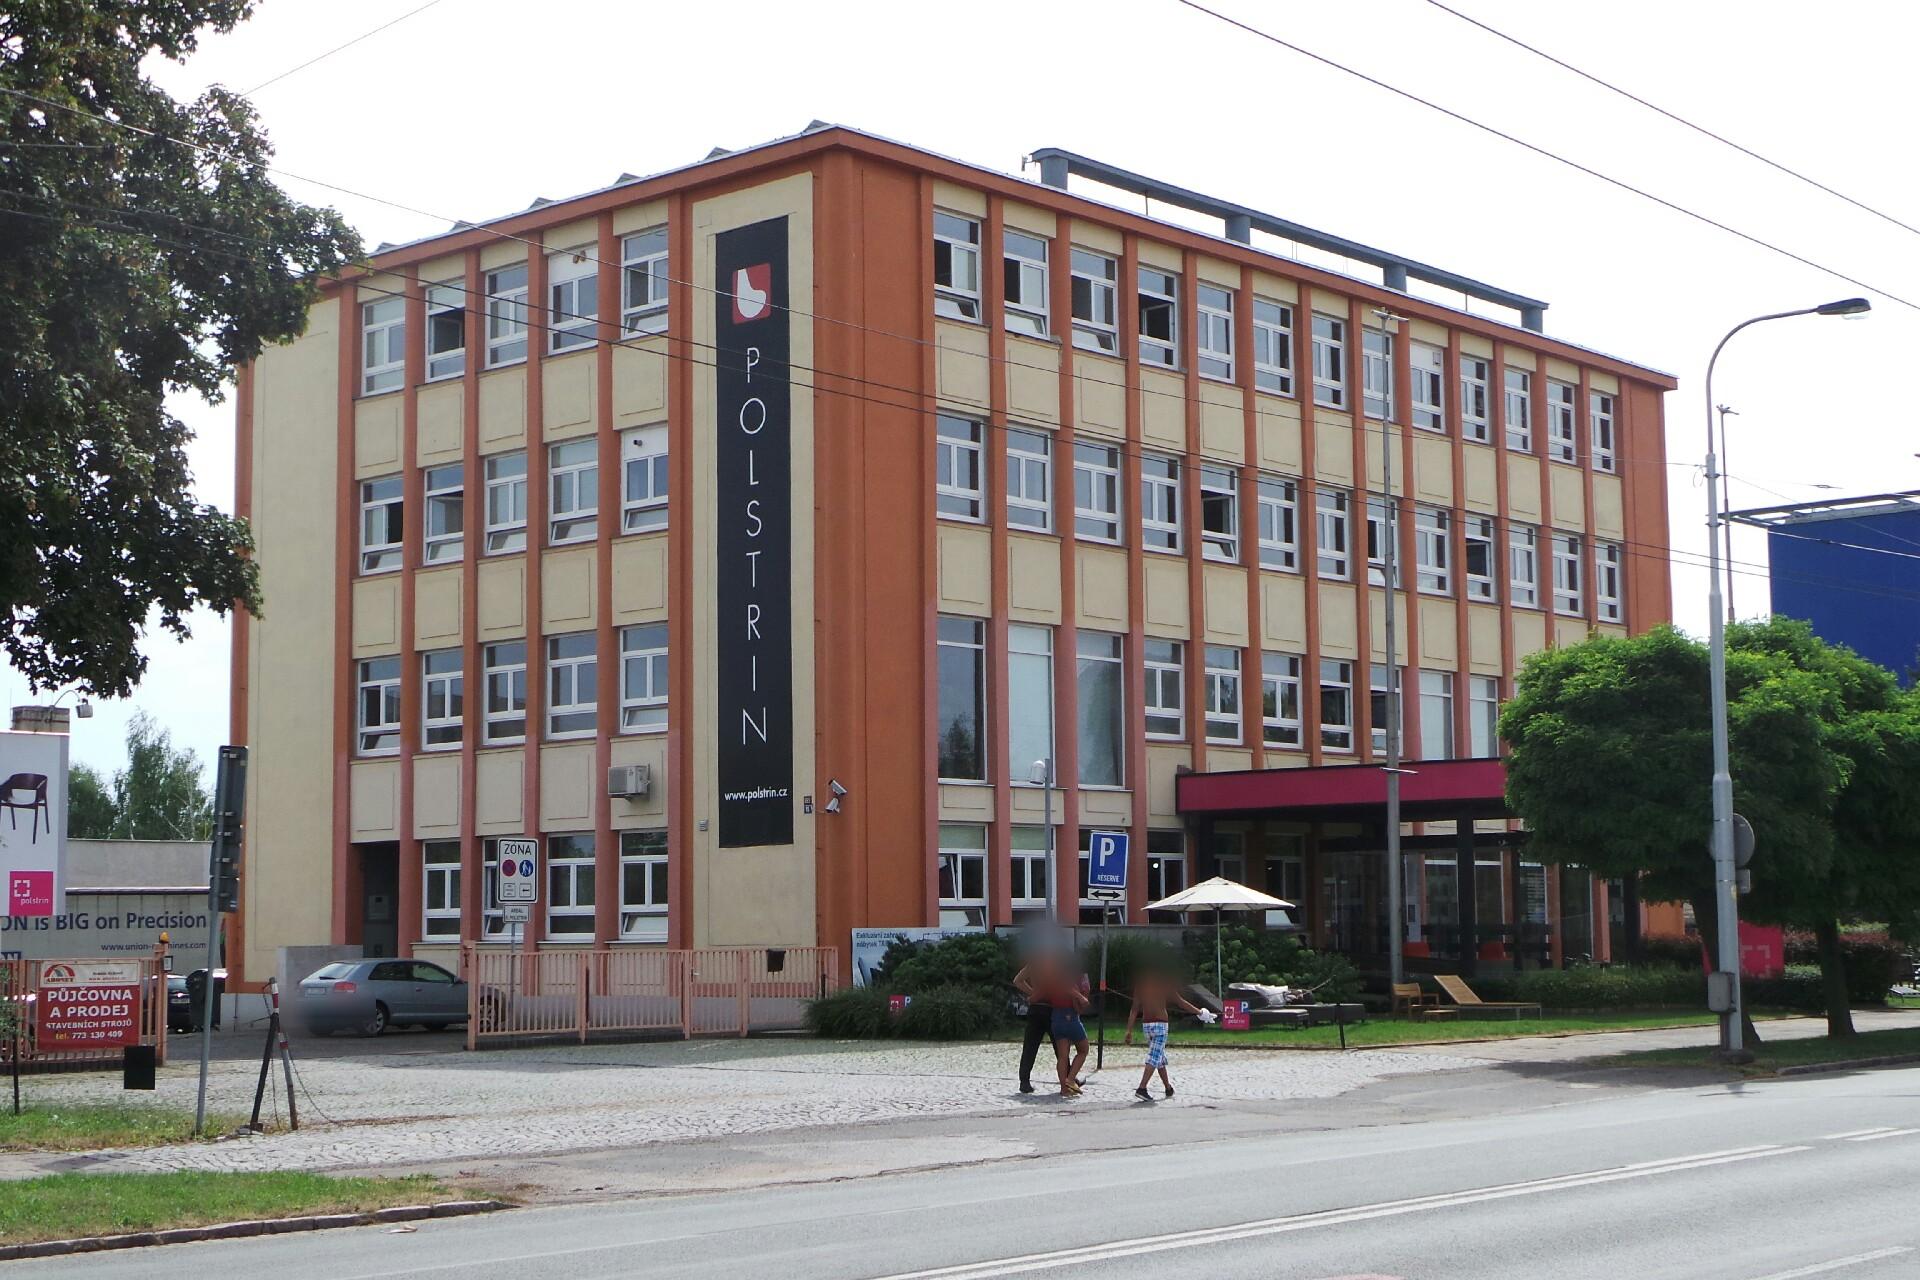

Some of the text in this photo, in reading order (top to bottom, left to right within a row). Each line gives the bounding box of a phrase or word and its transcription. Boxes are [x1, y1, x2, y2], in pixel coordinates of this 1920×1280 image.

[739, 346, 768, 746] POLSTRIN
[724, 786, 788, 803] www.polstrin.cz
[1099, 837, 1115, 867] P
[56, 913, 89, 931] BIG
[95, 916, 120, 930] on
[126, 911, 207, 929] Precision
[47, 986, 133, 1002] PŮJČOVNA
[50, 1004, 129, 1018] A PRODEJ
[46, 1018, 132, 1029] STAVEBNÍCH STROJŮ
[55, 1032, 69, 1040] tel.
